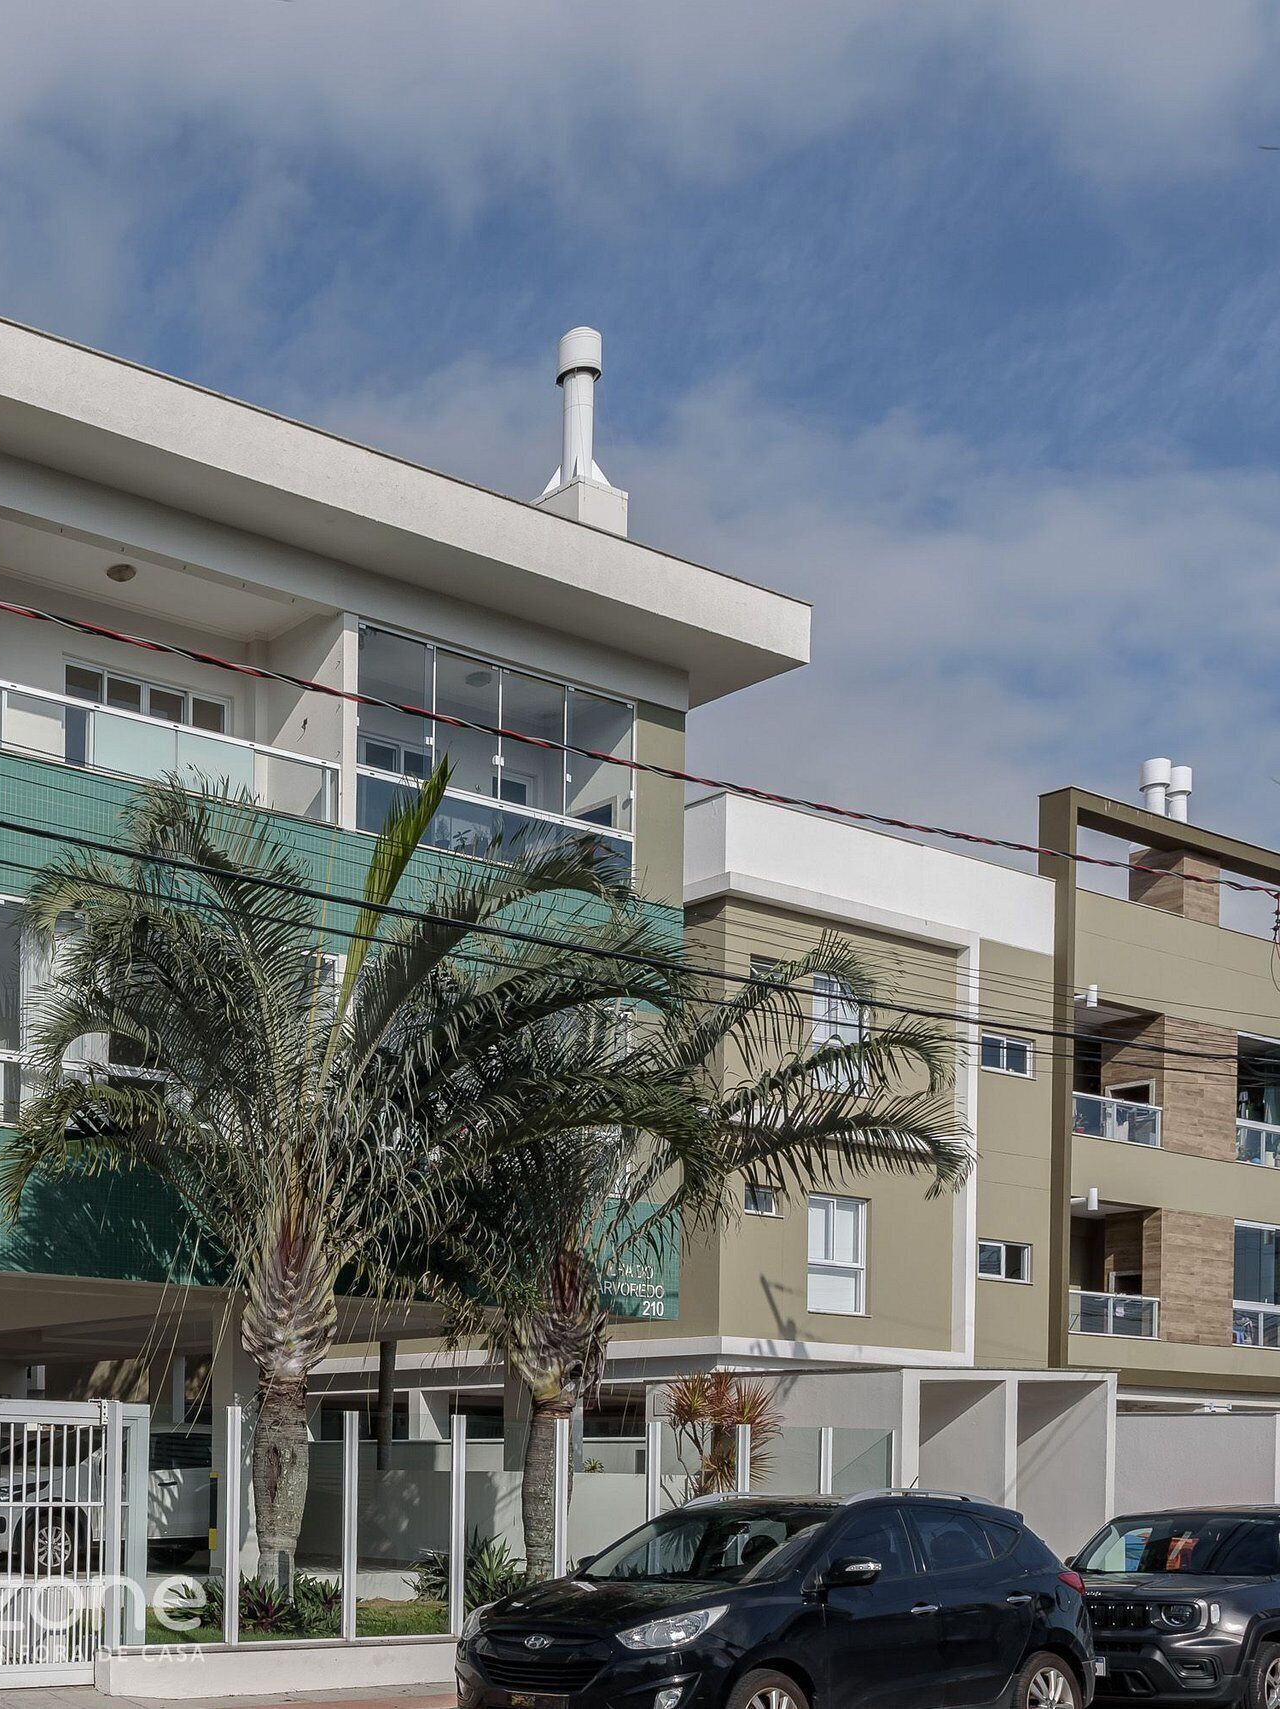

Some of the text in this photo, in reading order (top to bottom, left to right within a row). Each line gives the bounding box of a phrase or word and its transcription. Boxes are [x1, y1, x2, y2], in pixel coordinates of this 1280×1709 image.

[606, 1263, 653, 1279] LHA DO
[599, 1280, 664, 1298] ARVOREDO
[642, 1301, 664, 1316] 210
